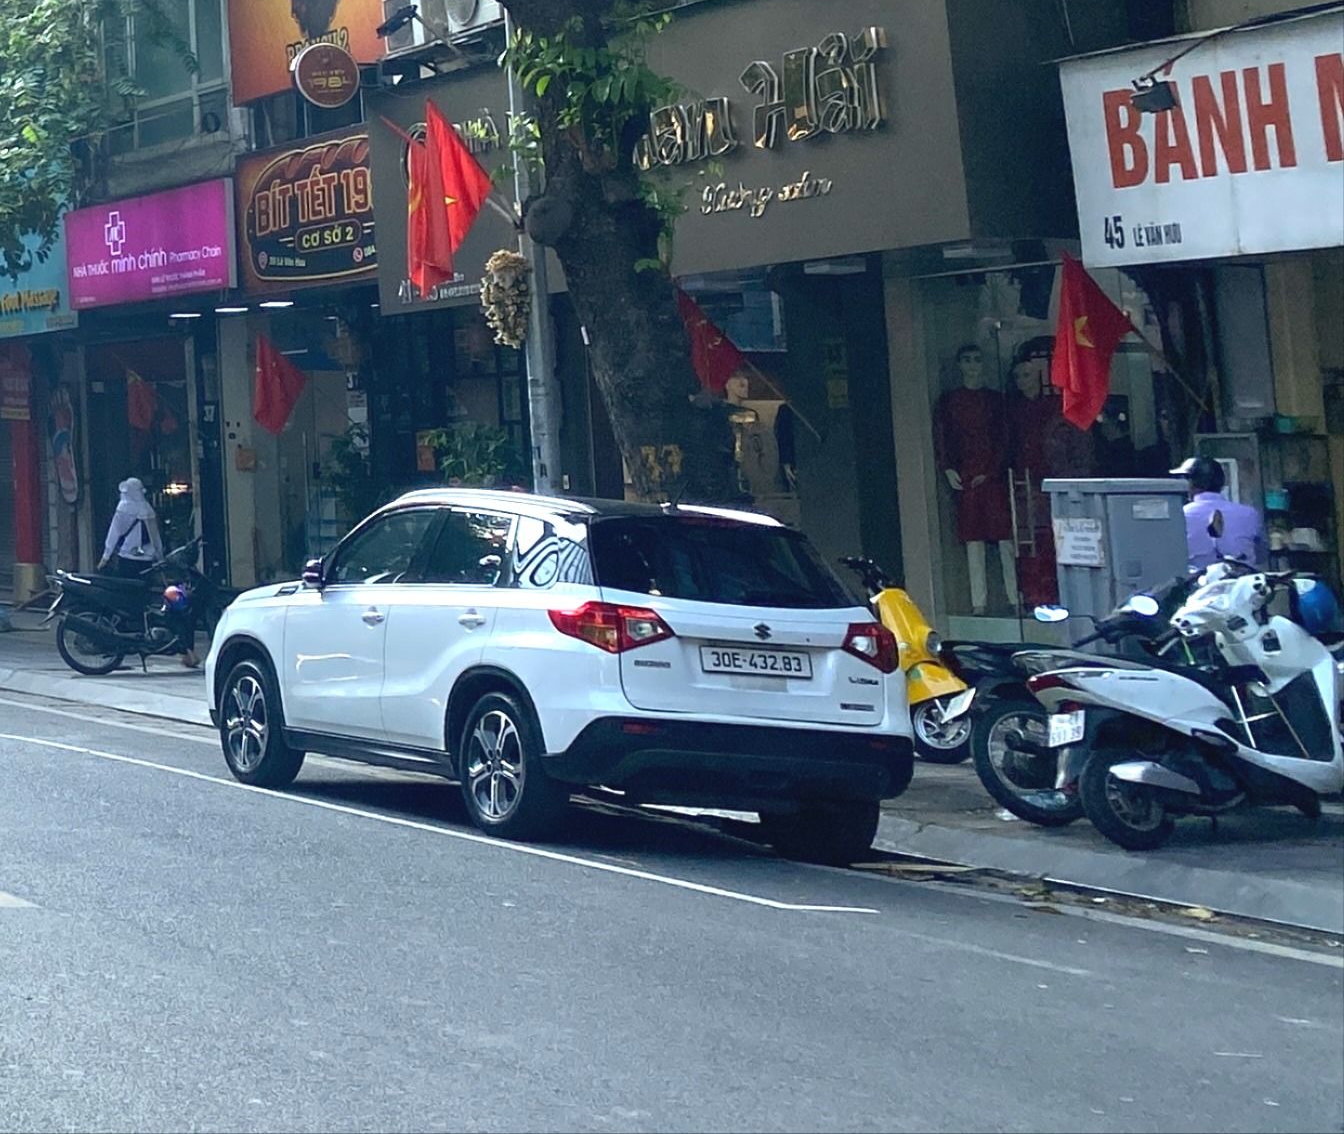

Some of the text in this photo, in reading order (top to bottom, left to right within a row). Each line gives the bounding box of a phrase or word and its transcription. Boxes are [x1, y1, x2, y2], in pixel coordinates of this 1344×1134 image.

[1103, 58, 1298, 190] BÁNH
[255, 163, 374, 238] BÍT TẾT 19
[302, 224, 354, 249] CƠ SỞ 2
[1104, 215, 1126, 250] 45
[1132, 223, 1145, 248] LÊ
[1145, 220, 1164, 247] VĂN
[138, 247, 168, 270] chính
[711, 650, 803, 673] 30E-432.83
